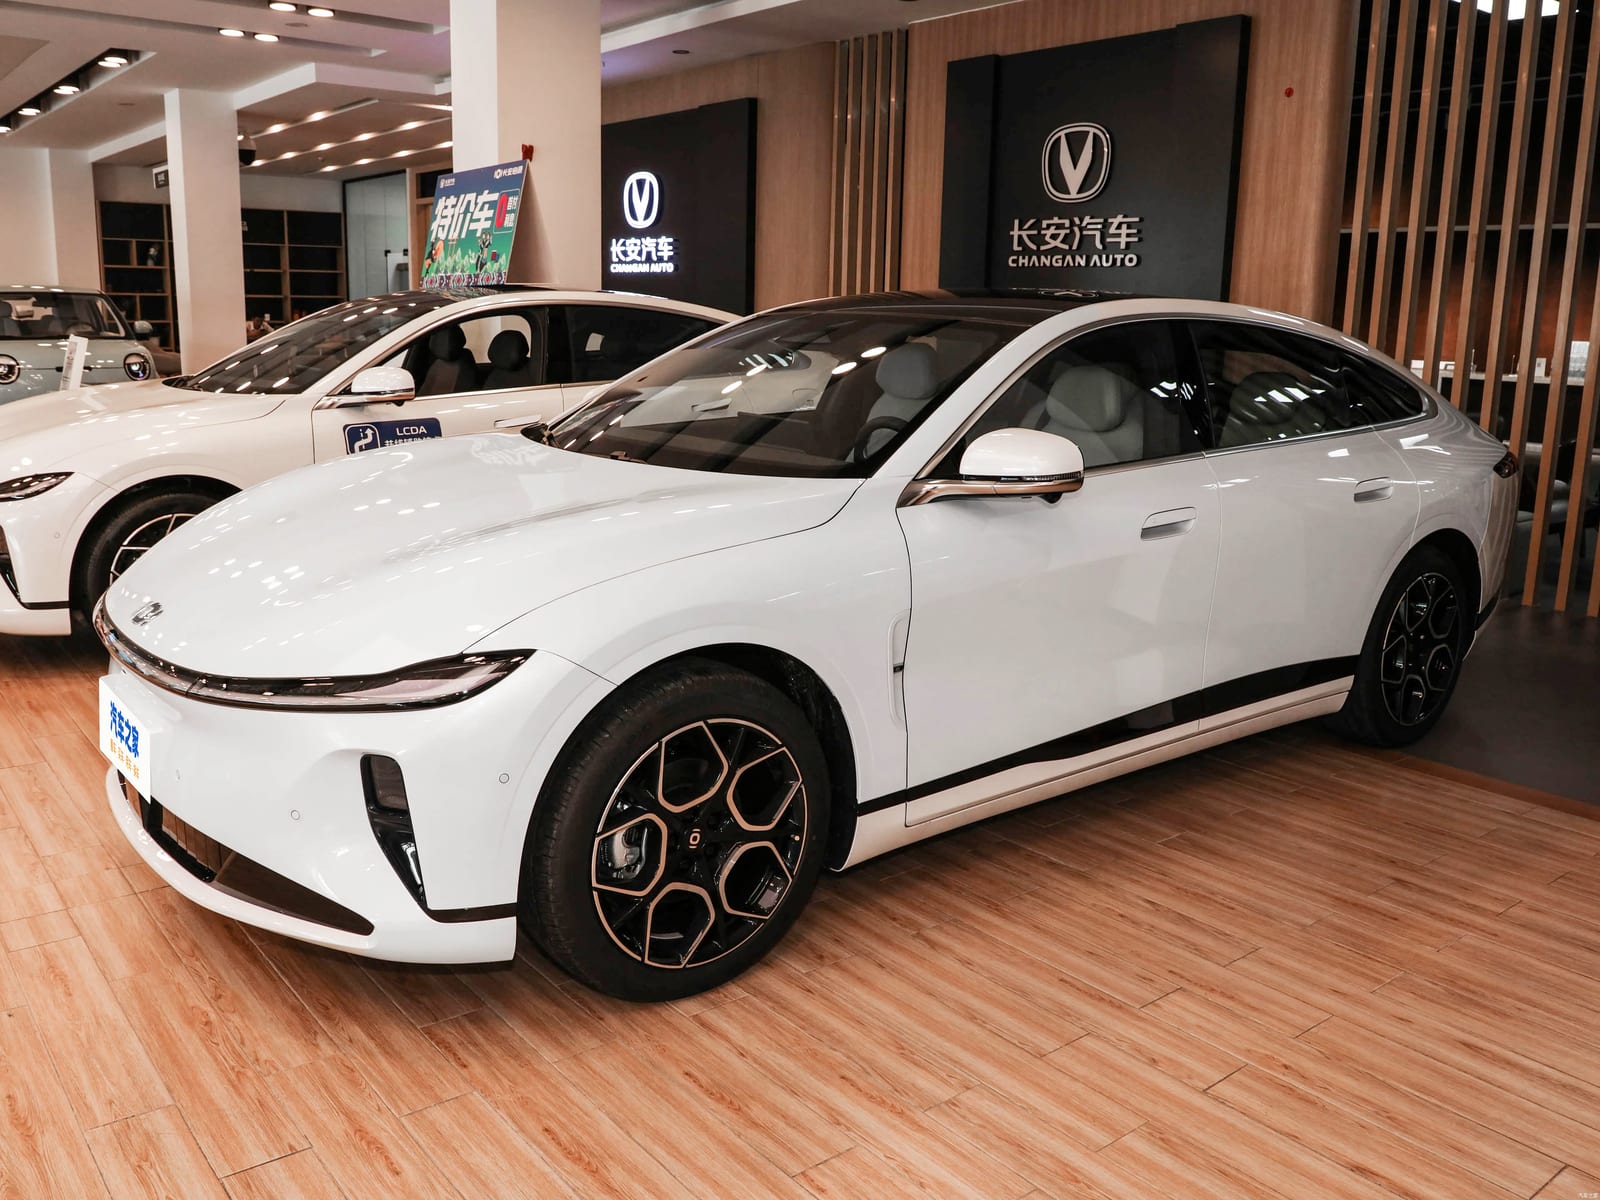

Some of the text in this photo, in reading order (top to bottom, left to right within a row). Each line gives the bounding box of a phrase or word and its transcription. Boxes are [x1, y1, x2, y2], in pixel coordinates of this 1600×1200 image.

[430, 190, 499, 241] 特价车
[495, 193, 508, 229] 0
[1009, 214, 1140, 251] 长安汽车
[610, 236, 674, 262] 长安汽车
[1008, 254, 1138, 267] CHANGAN AUTO
[650, 262, 675, 273] AUTO
[396, 425, 427, 436] LCDA
[110, 700, 139, 758] 汽车之家
